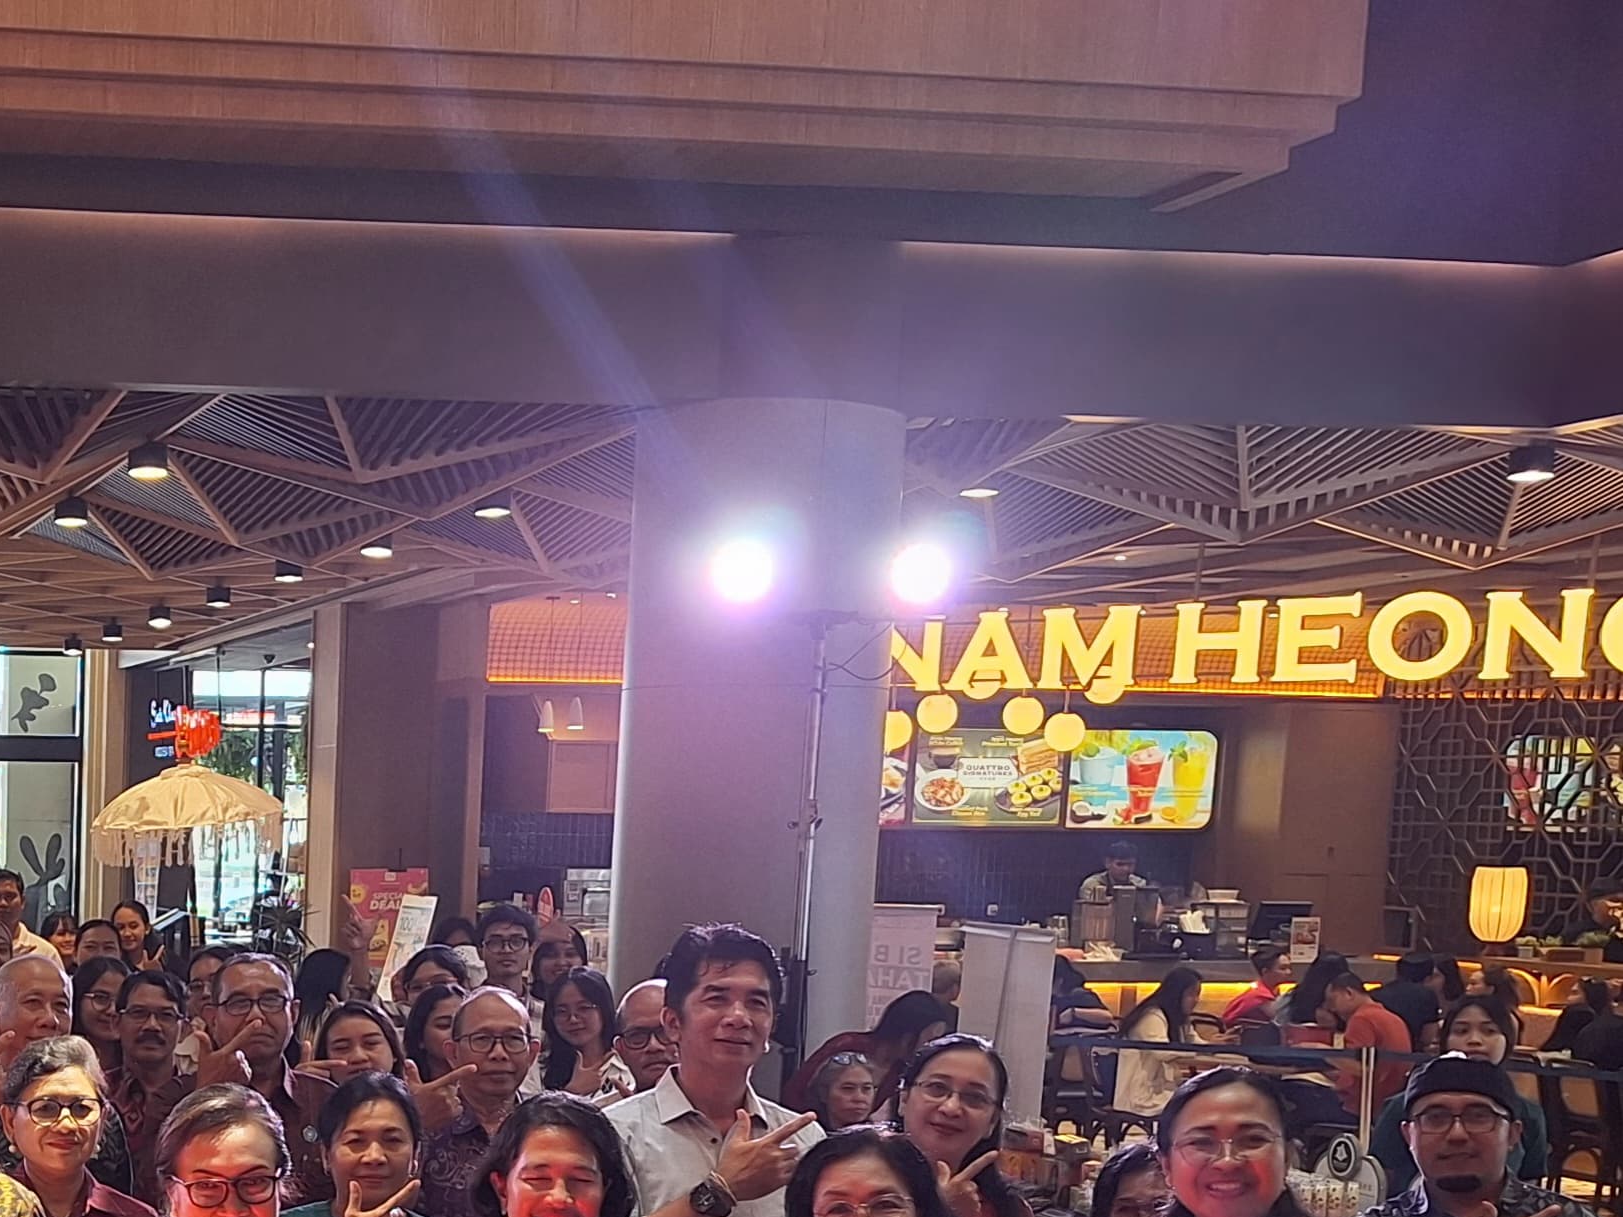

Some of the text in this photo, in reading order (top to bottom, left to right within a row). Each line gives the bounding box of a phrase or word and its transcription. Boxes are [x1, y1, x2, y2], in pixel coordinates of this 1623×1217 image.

[890, 589, 1623, 692] NAM HEON
[372, 892, 403, 900] SPECIA
